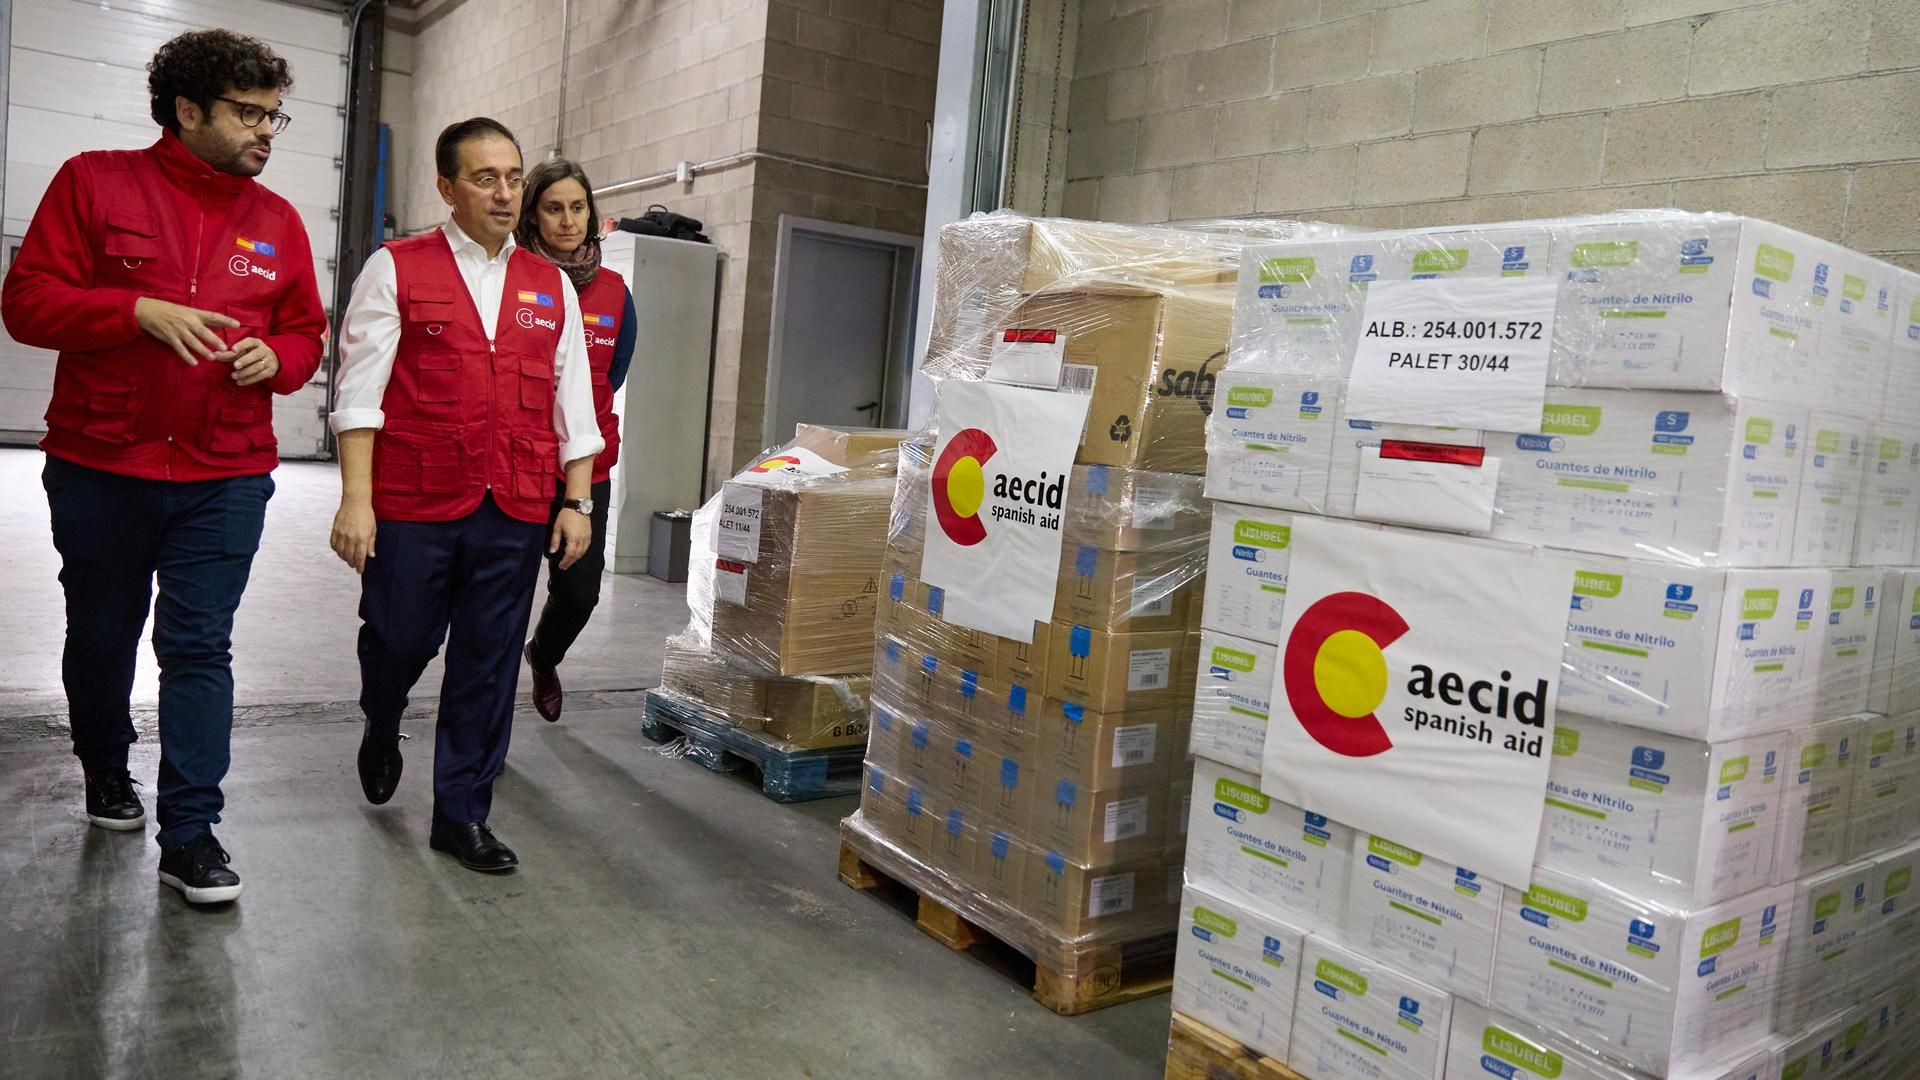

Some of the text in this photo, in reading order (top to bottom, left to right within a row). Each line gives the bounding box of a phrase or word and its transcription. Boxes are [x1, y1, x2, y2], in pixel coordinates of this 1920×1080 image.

[251, 265, 276, 281] aecid
[1632, 294, 1648, 304] de
[1652, 293, 1693, 304] Nitrilo
[534, 317, 556, 331] aecid
[1366, 321, 1543, 340] ALB.: 254.001.572
[595, 337, 615, 347] aecid
[1388, 353, 1510, 372] PALET 30/44
[1306, 393, 1313, 401] S
[1667, 413, 1677, 425] S
[1231, 428, 1307, 443] Guantes de Nitrilo
[1520, 437, 1547, 449] Nitrilo
[1536, 458, 1590, 473] Guantes
[1593, 463, 1610, 476] de
[1614, 465, 1657, 480] Nitrilo
[992, 471, 1066, 511] aecid
[991, 503, 1060, 531] spanish aid
[1240, 527, 1285, 543] LISUBEL
[1246, 567, 1283, 582] Guantes
[1675, 585, 1683, 596] S
[1615, 629, 1631, 641] de
[1635, 632, 1675, 649] Nitrilo
[1250, 697, 1262, 707] de
[1407, 663, 1549, 729] aecid
[1403, 706, 1493, 744] spanish
[1503, 731, 1544, 758] aid
[1643, 750, 1653, 762] S
[1220, 785, 1263, 809] LISUBEL
[1572, 787, 1589, 801] de
[1592, 793, 1634, 813] Nitrilo
[1216, 805, 1235, 818] Nitrilo
[1227, 825, 1307, 863] Guantes de Nitrilo
[1373, 879, 1463, 921] Guantes de Nitrilo
[1529, 889, 1580, 917] LISUBEL
[1198, 948, 1272, 988] Guantes de Nitrilo
[1529, 935, 1639, 984] Guantes de Nitrilo
[1321, 1005, 1408, 1054] Guantes de Nitrilo
[1490, 1034, 1554, 1073] LISUBEL
[1485, 1059, 1511, 1077] Nitrilo
